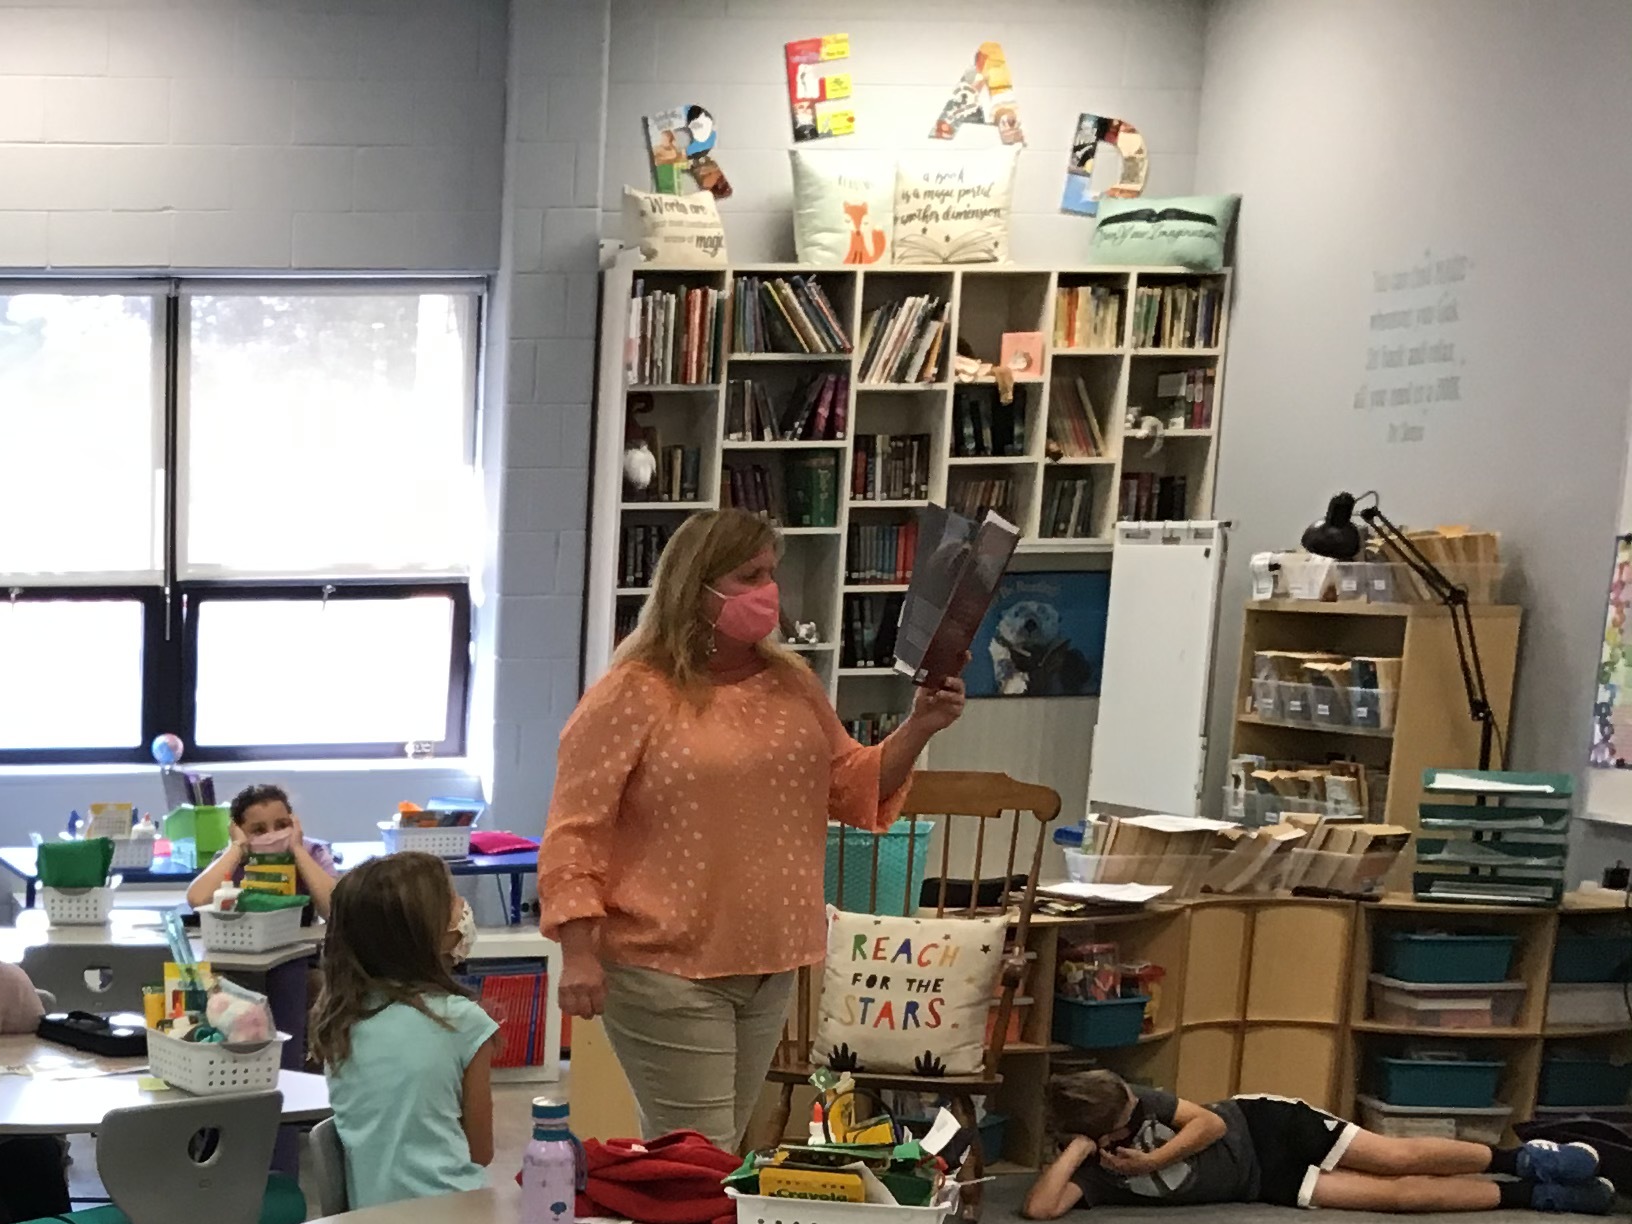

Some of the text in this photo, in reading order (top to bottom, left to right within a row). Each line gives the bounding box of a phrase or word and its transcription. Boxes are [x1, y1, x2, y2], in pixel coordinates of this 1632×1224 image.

[852, 933, 960, 968] REACH
[851, 972, 945, 994] FOR THE
[839, 994, 946, 1031] STARS
